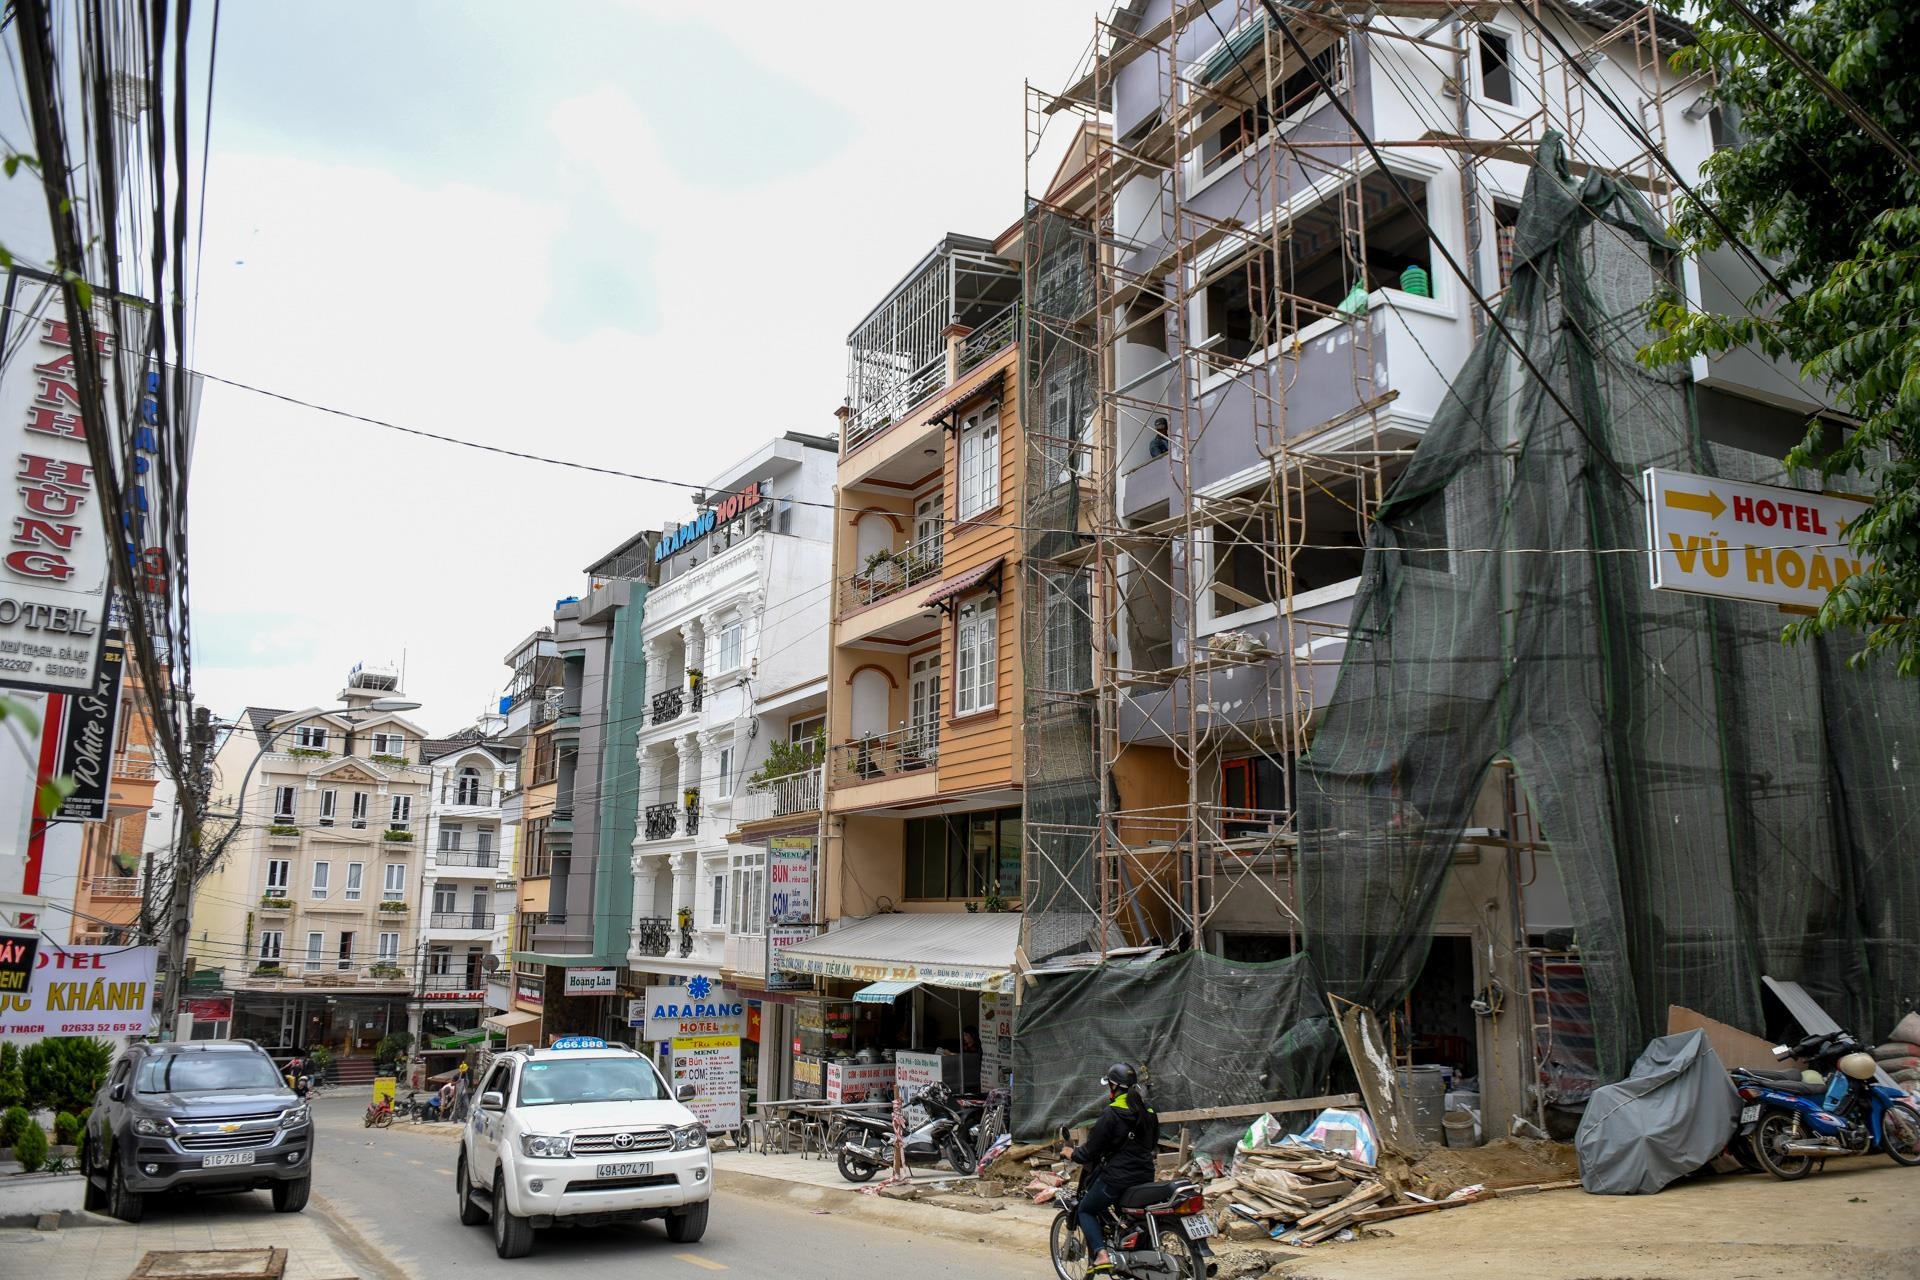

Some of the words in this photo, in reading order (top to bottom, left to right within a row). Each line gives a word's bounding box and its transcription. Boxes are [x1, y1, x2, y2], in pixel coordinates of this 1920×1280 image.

[655, 510, 715, 563] ARAPANG
[717, 481, 763, 525] HOTEL
[1733, 495, 1828, 536] HOTEL
[1668, 531, 1729, 578] VŨ
[1745, 544, 1887, 592] HOÀN
[72, 720, 105, 788] White
[772, 937, 793, 946] THU
[0, 940, 25, 963] ÁY
[853, 964, 888, 980] THU
[46, 977, 147, 1011] KHÁNH
[653, 1003, 743, 1018] ARAPANG
[61, 1024, 94, 1032] 02633
[97, 1024, 110, 1032] 52
[129, 1023, 141, 1031] 52
[680, 1021, 719, 1033] HOTEL
[689, 1068, 705, 1080] CƠM
